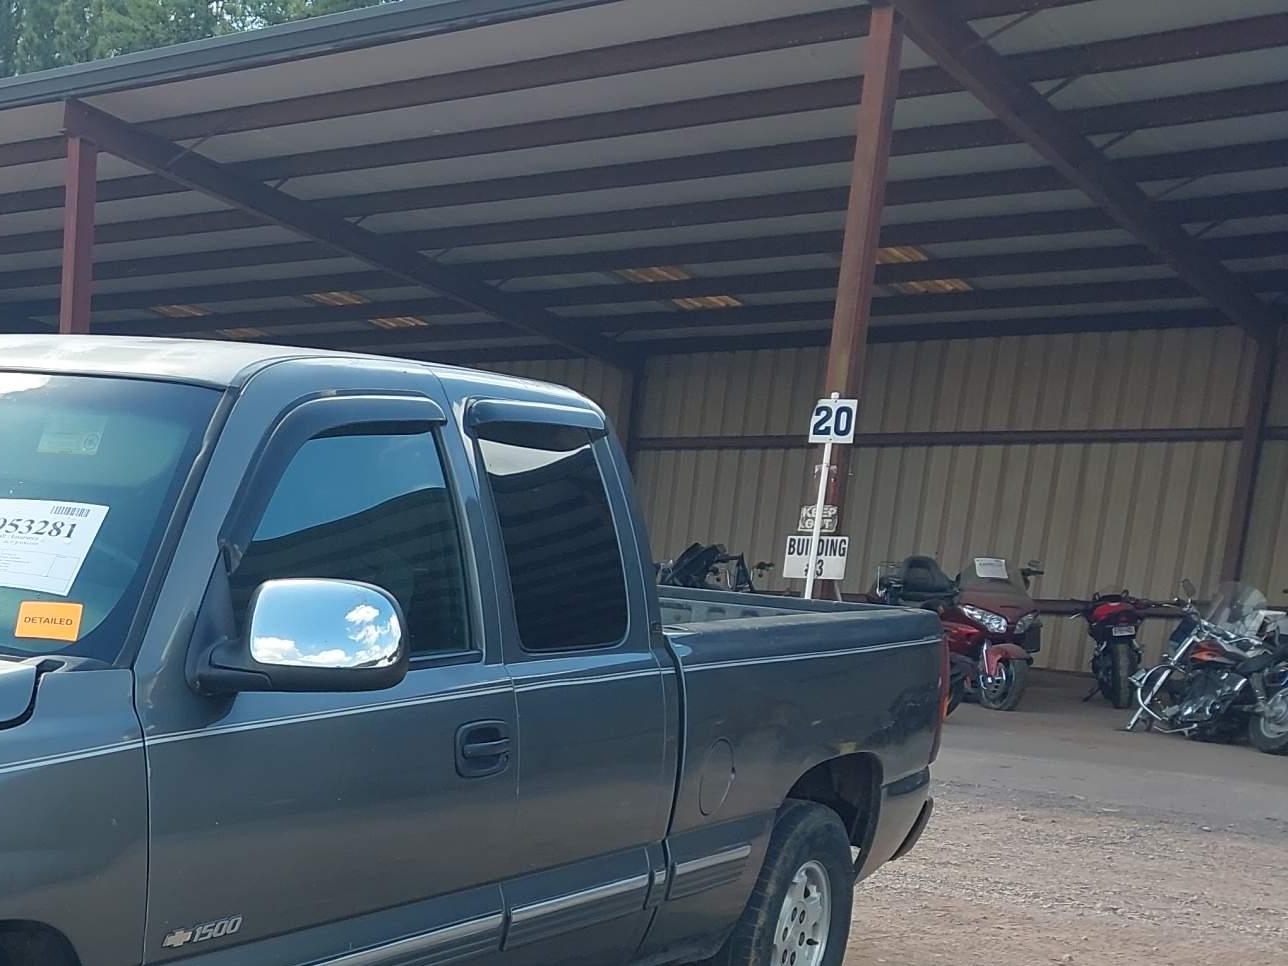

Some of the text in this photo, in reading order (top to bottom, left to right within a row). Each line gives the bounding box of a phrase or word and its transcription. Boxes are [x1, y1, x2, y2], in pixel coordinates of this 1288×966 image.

[813, 405, 853, 437] 20
[804, 518, 833, 529] OT
[23, 615, 74, 626] DETAILED
[192, 915, 243, 943] 1500
